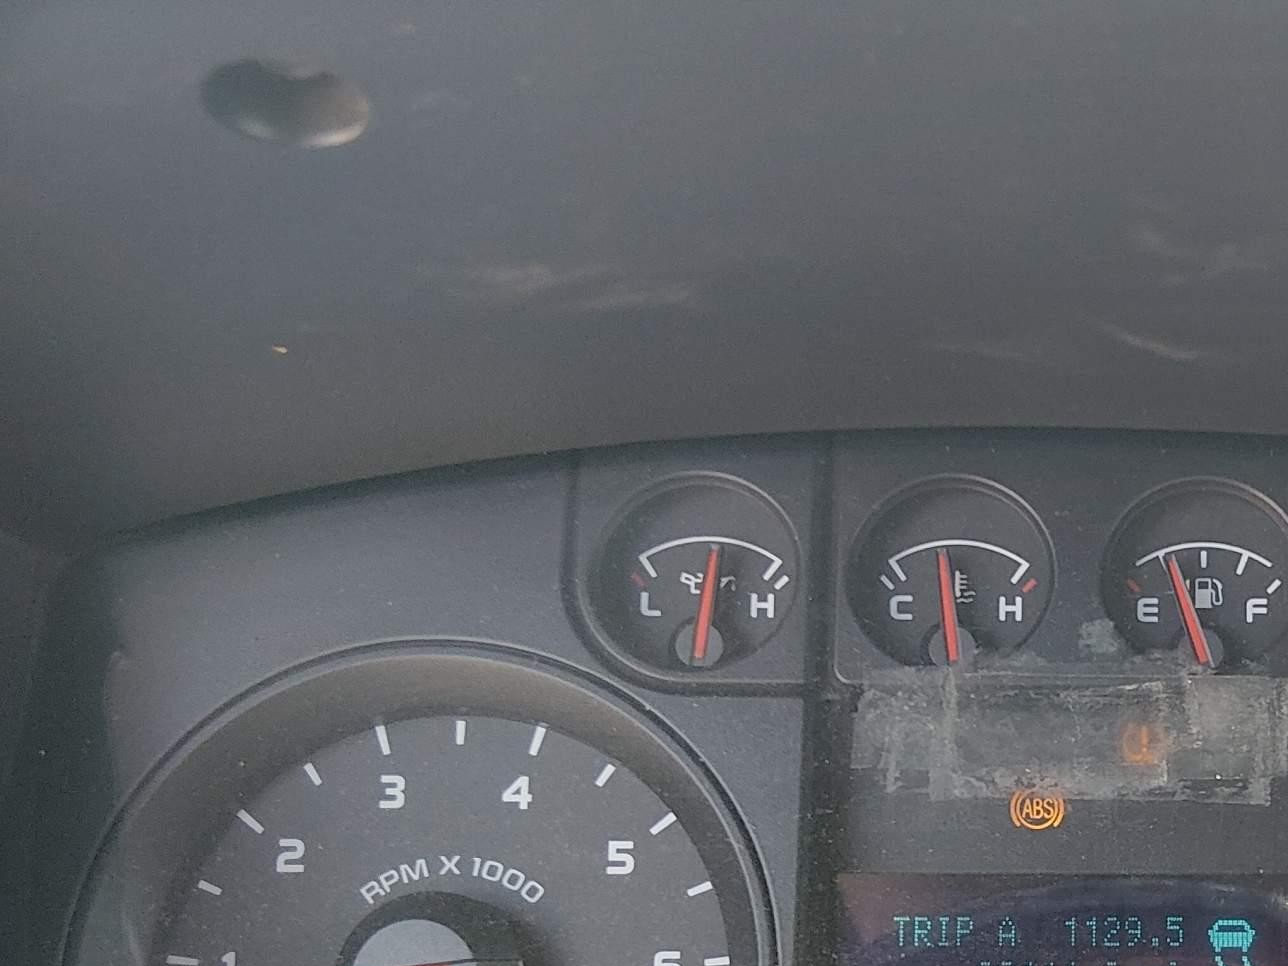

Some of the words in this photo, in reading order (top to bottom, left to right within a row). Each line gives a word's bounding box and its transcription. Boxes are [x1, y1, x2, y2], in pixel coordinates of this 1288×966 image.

[639, 592, 662, 617] L
[749, 592, 775, 619] H
[889, 594, 914, 621] C
[999, 596, 1023, 622] H
[1136, 599, 1159, 623] E
[1246, 599, 1268, 623] F
[379, 774, 405, 809] 3
[501, 775, 533, 810] 4
[1022, 798, 1054, 820] ABS
[275, 838, 305, 873] 2
[605, 840, 635, 876] 5
[360, 856, 430, 904] RPM
[438, 854, 462, 877] X
[471, 856, 546, 903] 1000
[893, 916, 974, 947] TRIP
[998, 916, 1017, 947] A
[1064, 916, 1184, 947] 1129.5
